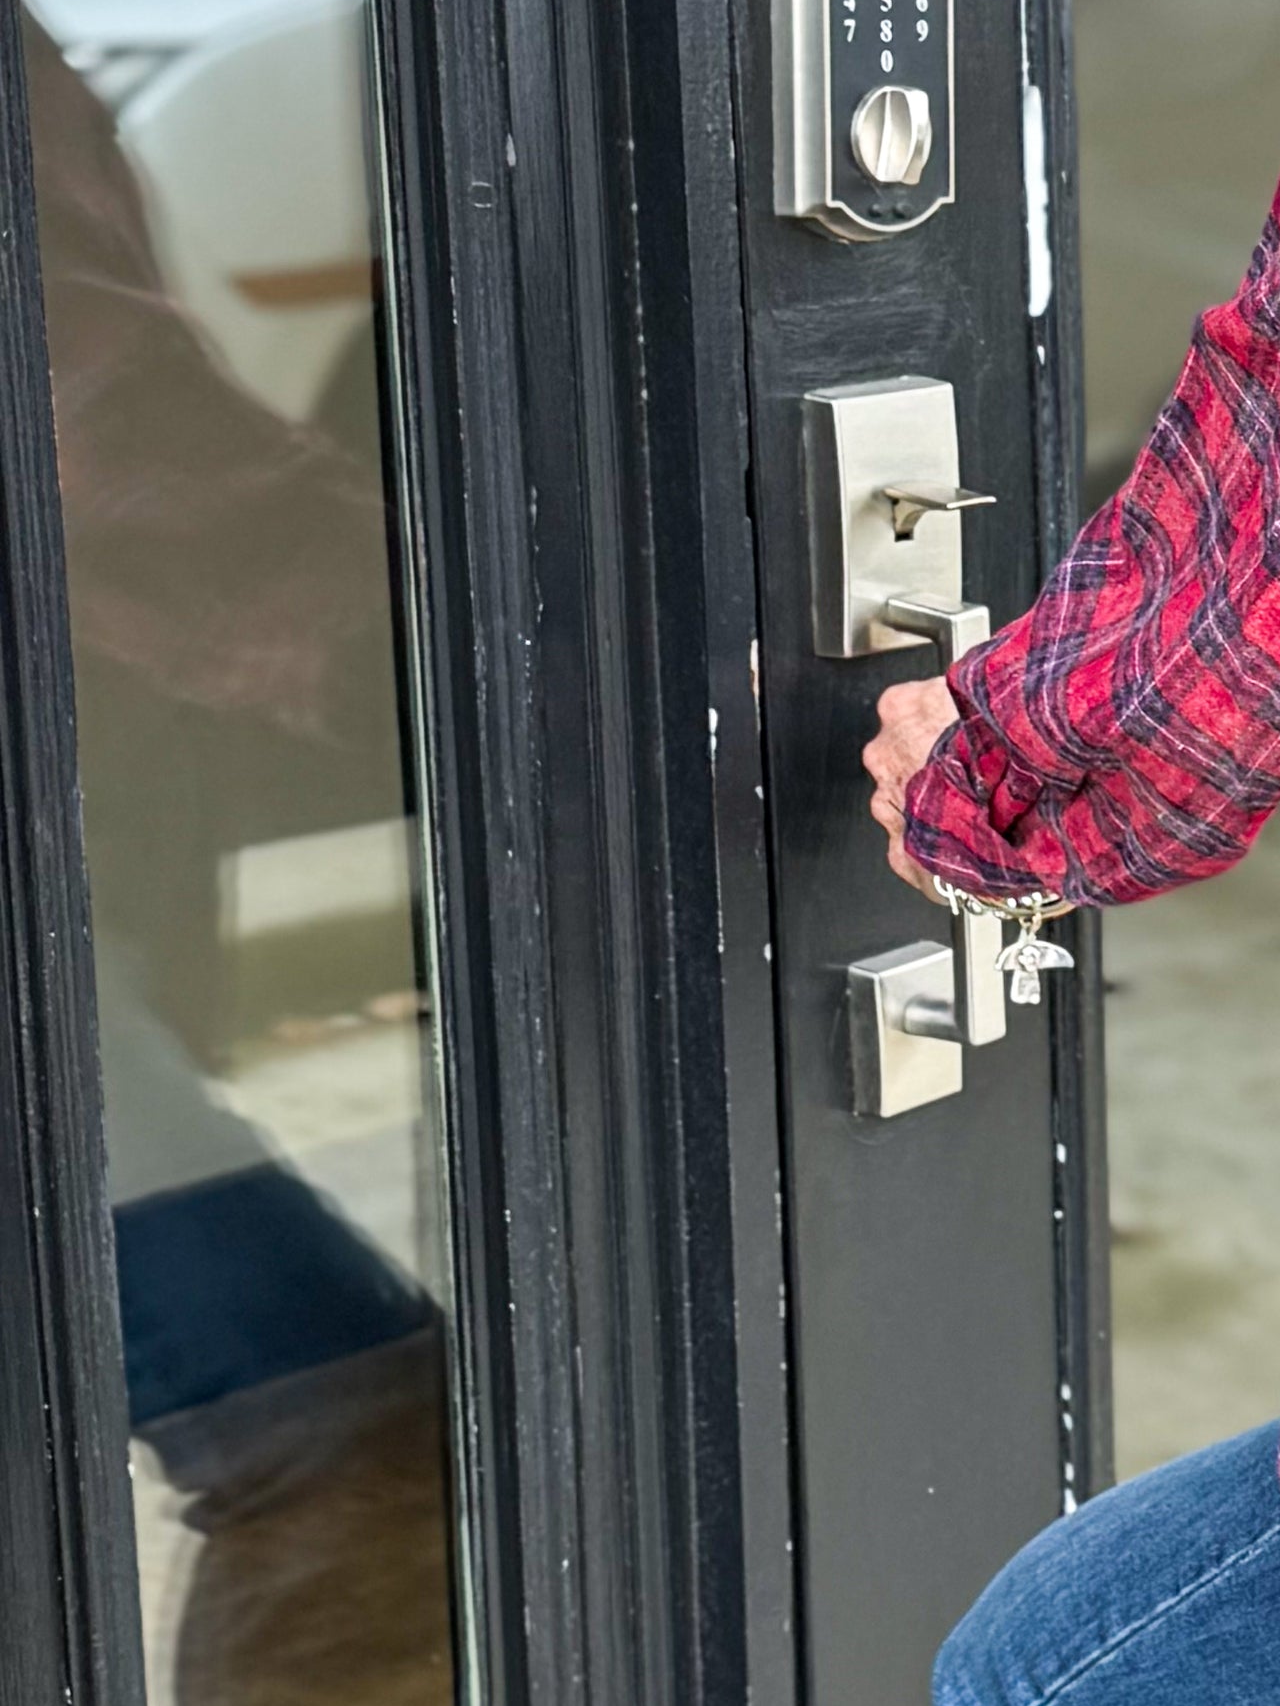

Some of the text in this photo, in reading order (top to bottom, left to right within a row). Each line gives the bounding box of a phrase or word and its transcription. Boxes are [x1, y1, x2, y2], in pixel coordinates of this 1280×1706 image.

[843, 19, 929, 42] 7 8 9
[880, 50, 893, 72] 0
